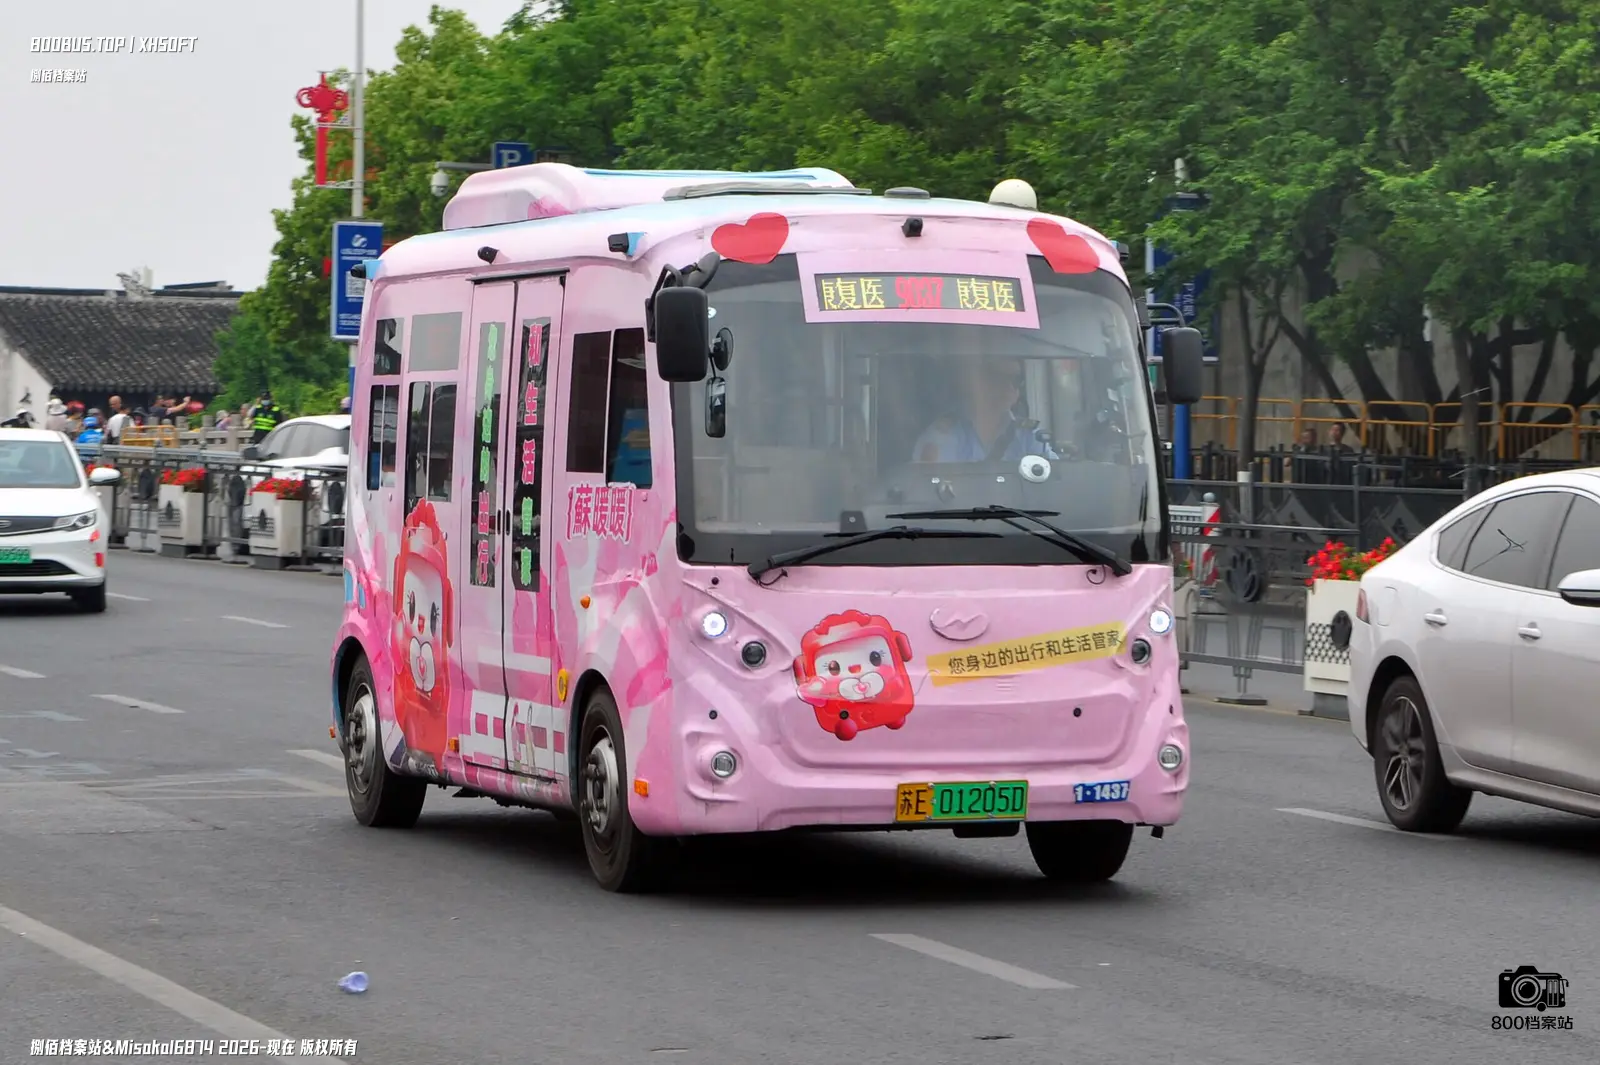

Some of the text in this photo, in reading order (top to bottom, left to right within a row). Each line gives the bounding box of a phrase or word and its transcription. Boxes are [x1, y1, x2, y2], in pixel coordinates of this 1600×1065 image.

[499, 149, 521, 168] P
[895, 276, 944, 309] 9037
[948, 629, 1120, 675] 您身边的出行和生活管家
